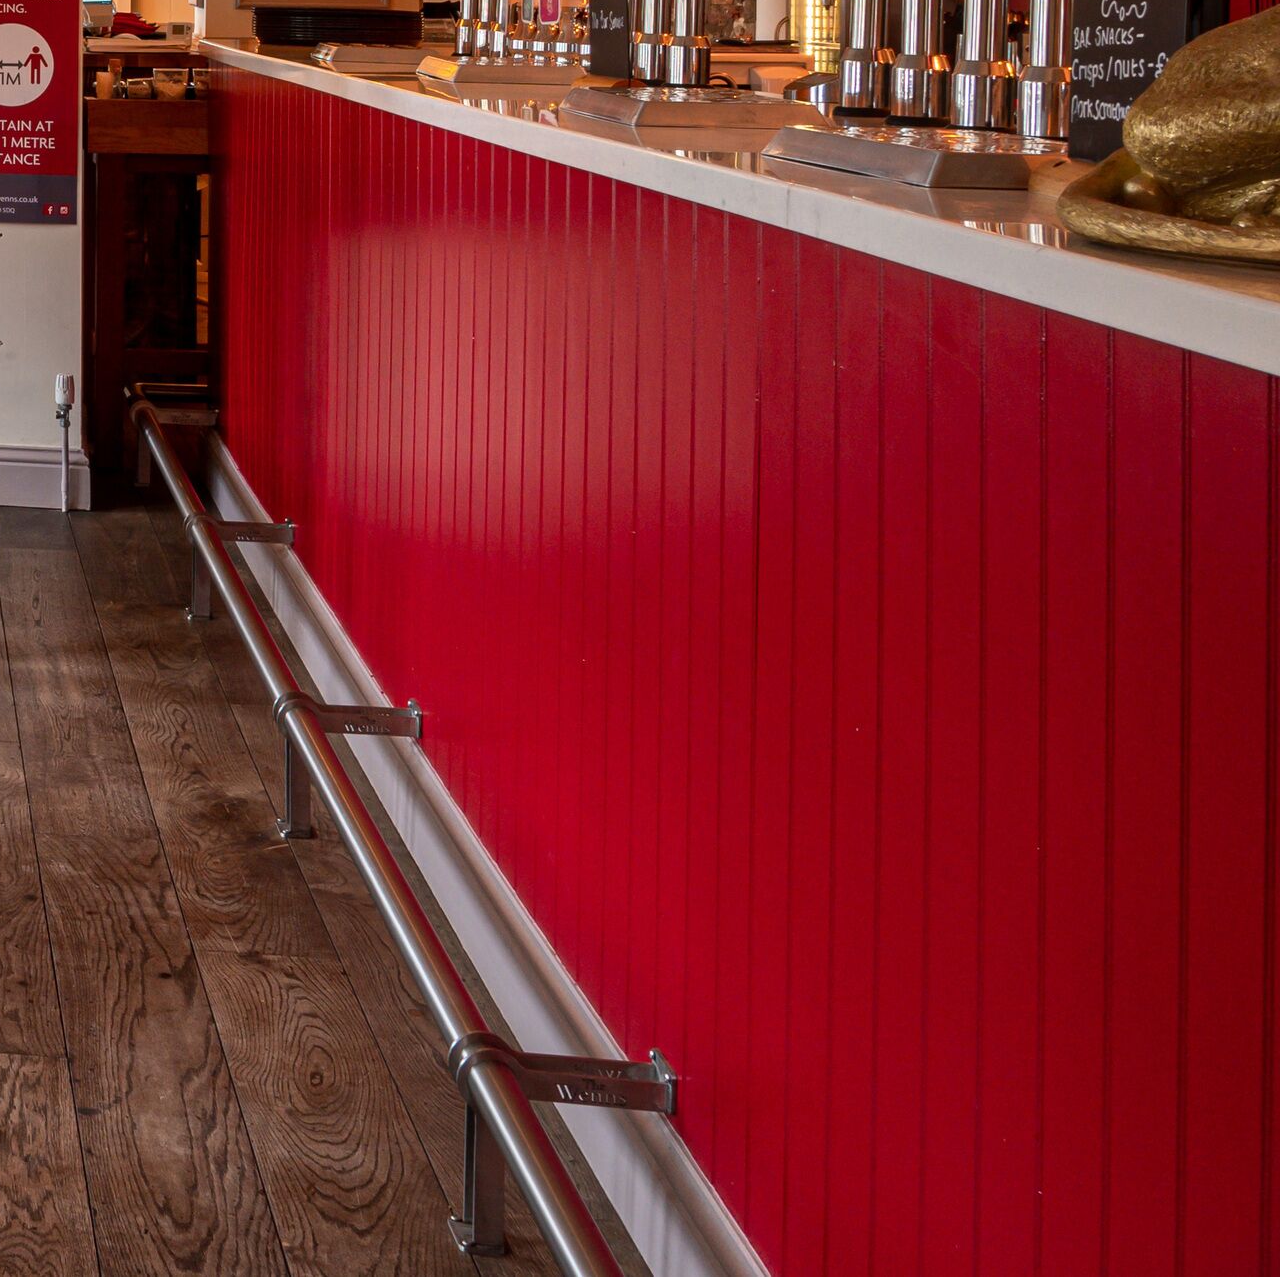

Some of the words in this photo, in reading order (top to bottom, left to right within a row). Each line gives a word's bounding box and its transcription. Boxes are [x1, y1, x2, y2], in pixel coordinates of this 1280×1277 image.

[1074, 27, 1091, 50] BAR
[1095, 26, 1134, 47] SNACKS
[0, 72, 21, 85] 1M
[35, 120, 54, 132] AT
[2, 136, 7, 148] 1
[11, 136, 56, 150] METRE
[556, 1083, 627, 1104] Wenns
